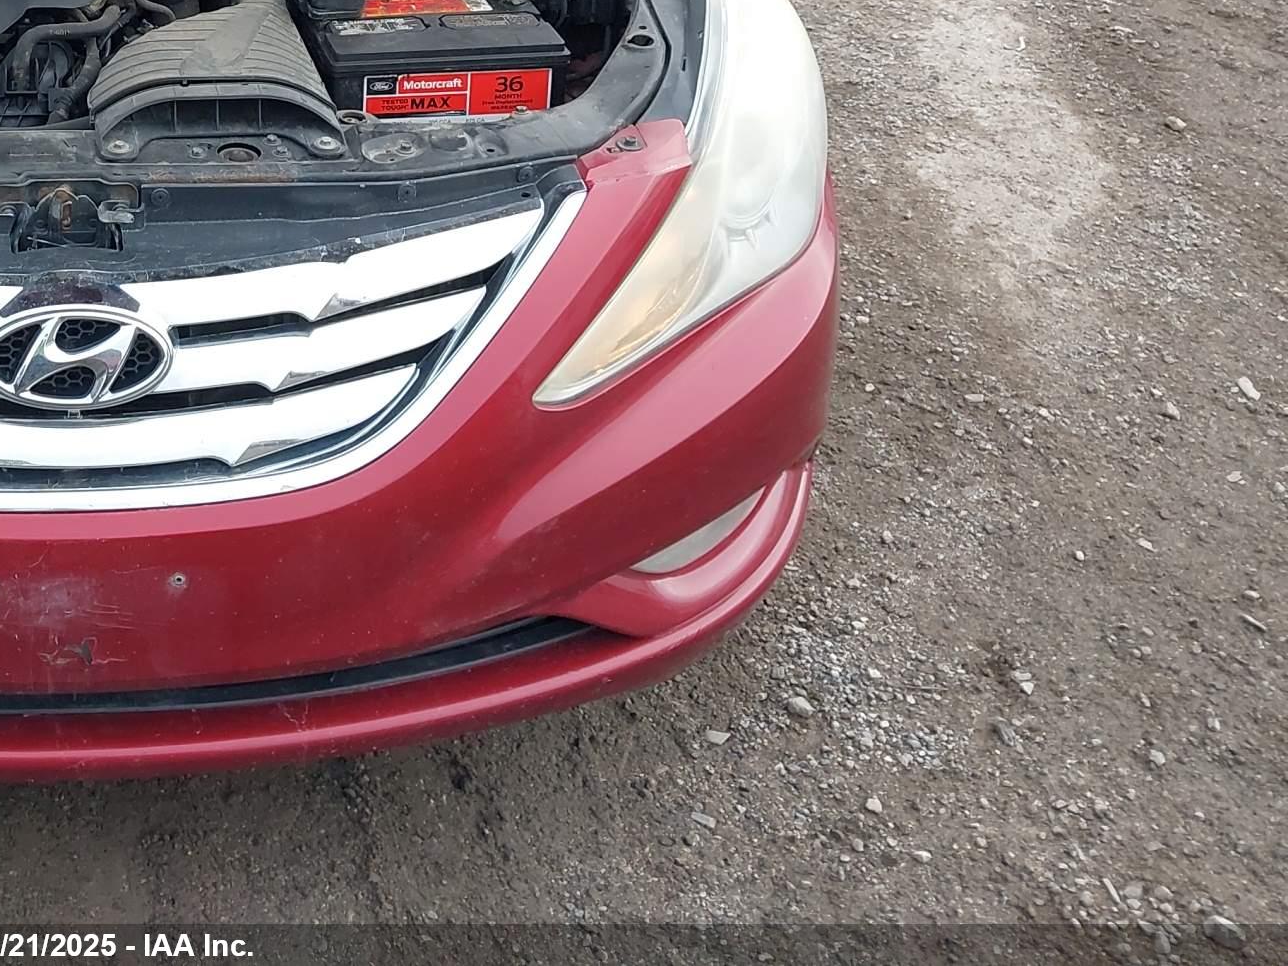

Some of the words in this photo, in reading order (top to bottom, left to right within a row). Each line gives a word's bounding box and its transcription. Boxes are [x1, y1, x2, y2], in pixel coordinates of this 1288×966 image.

[403, 78, 462, 90] Motorcraft
[495, 75, 524, 93] 36
[410, 96, 452, 110] MAX
